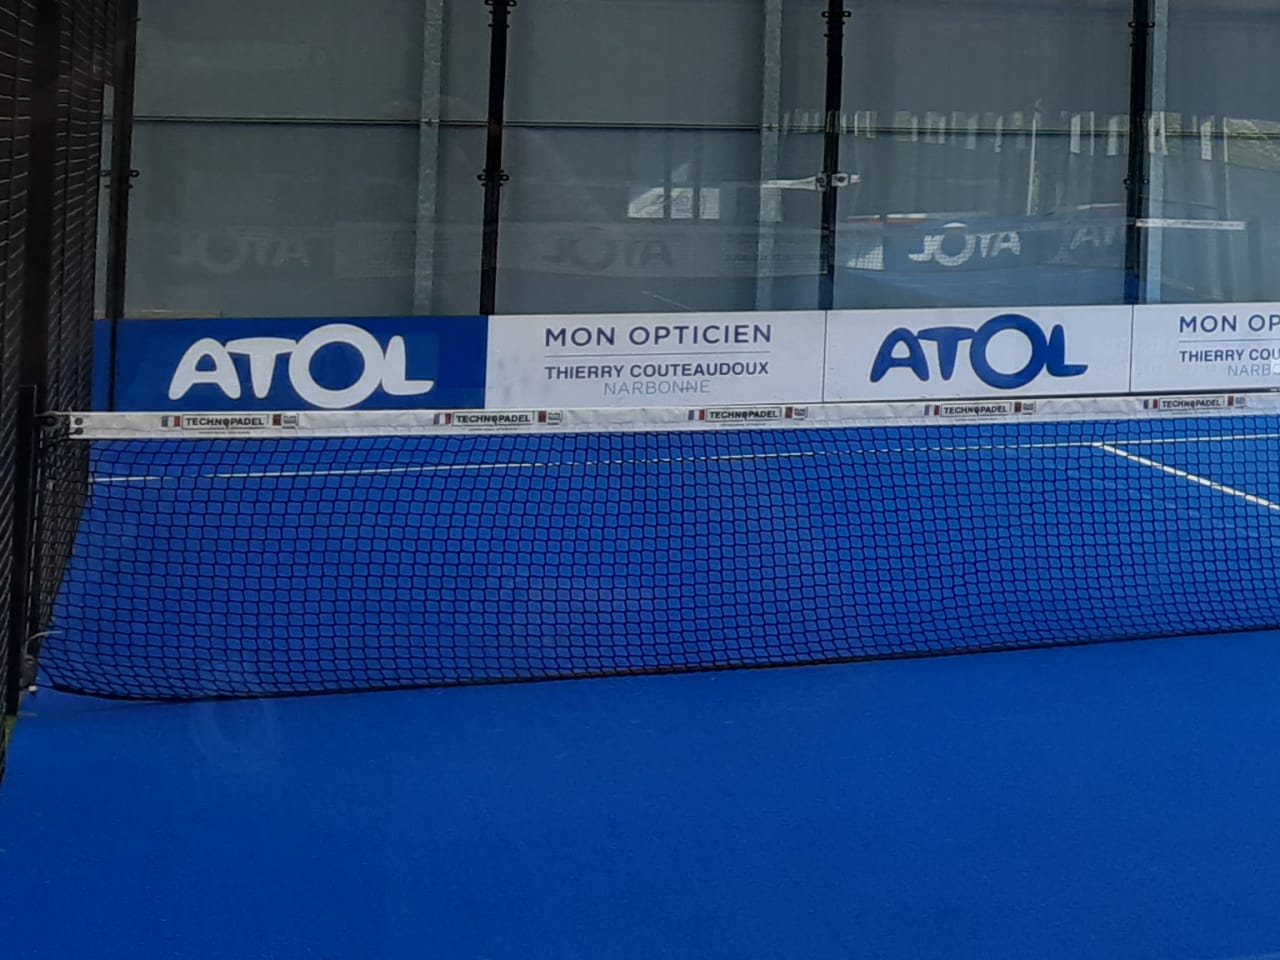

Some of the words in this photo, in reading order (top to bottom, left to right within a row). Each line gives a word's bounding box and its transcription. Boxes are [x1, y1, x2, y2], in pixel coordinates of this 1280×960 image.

[1179, 315, 1237, 334] MON
[544, 326, 616, 348] MON
[628, 324, 772, 346] OPTICIEN
[869, 313, 1089, 390] ATOL
[1179, 349, 1245, 363] THIERRY
[169, 323, 434, 408] ATOL
[544, 364, 624, 380] THIERRY
[629, 361, 769, 378] COUTEAUDOUX
[603, 379, 711, 396] NARBONNE
[456, 413, 531, 425] TECHNOPADEL
[710, 409, 779, 421] TECHNOPADEL
[944, 405, 1009, 416] TECHNOPADEL
[186, 416, 265, 428] TECHNOPADEL
